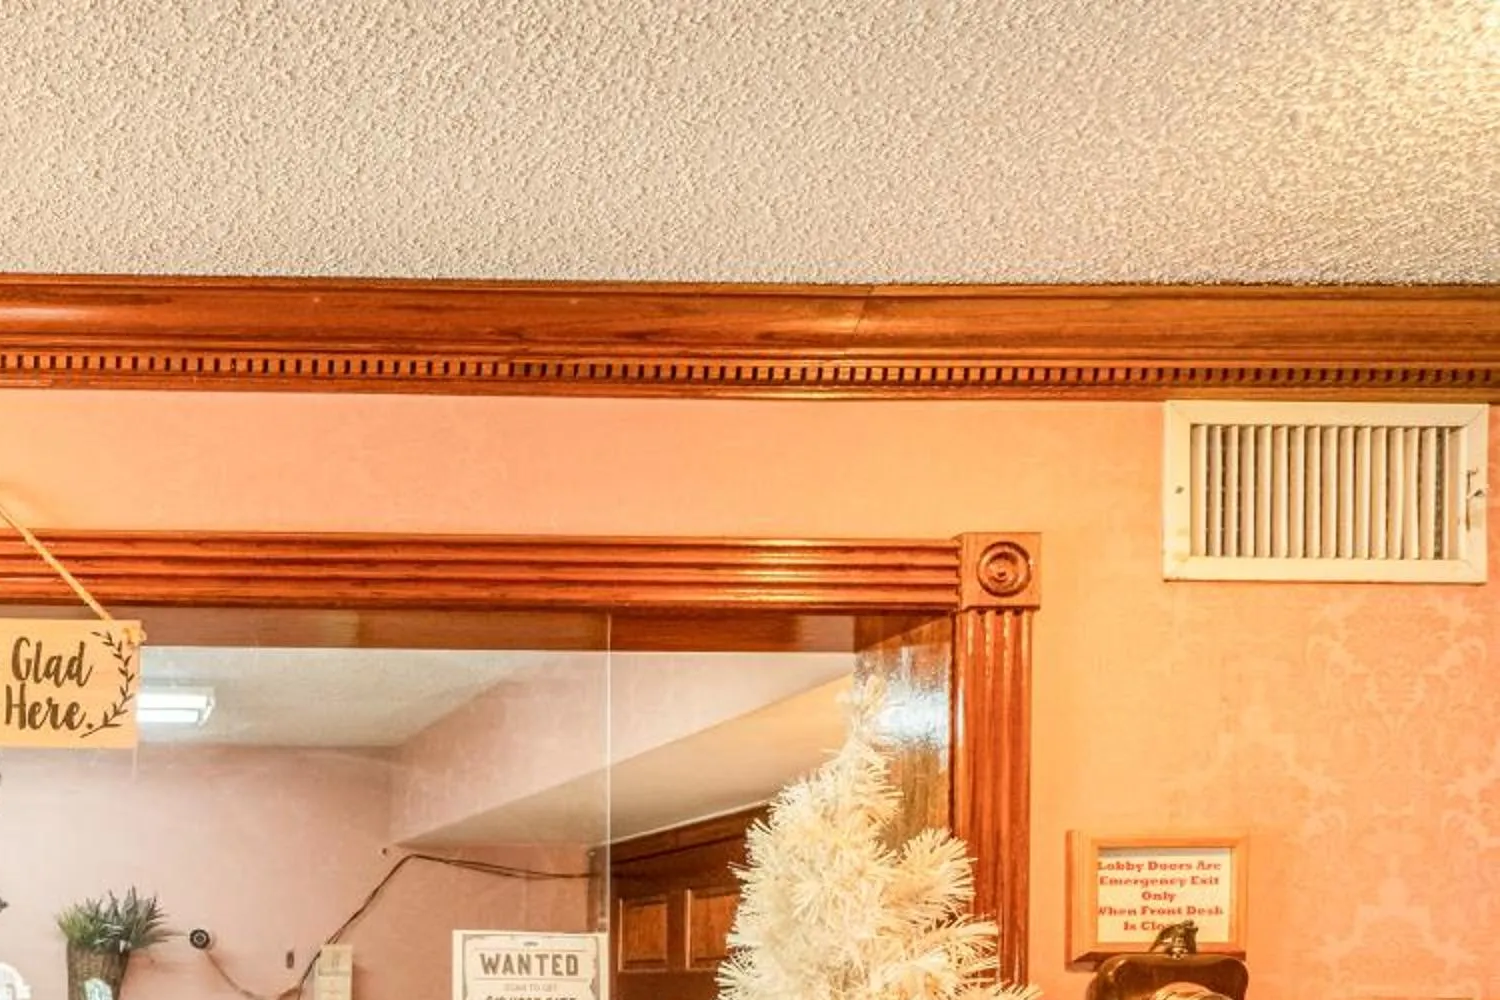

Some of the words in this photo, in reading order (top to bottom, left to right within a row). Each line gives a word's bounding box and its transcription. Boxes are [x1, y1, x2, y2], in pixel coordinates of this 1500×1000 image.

[11, 636, 93, 688] Glad
[5, 684, 95, 731] Here.
[1097, 860, 1144, 872] Lobby
[1147, 861, 1193, 871] Doors
[1196, 860, 1221, 870] Are
[1099, 876, 1188, 888] Emergency
[1190, 876, 1219, 885] Exit
[1141, 891, 1176, 902] Only
[1141, 906, 1182, 915] Front
[1186, 906, 1224, 915] Desk
[1123, 922, 1137, 931] Is
[479, 953, 580, 976] WANTED
